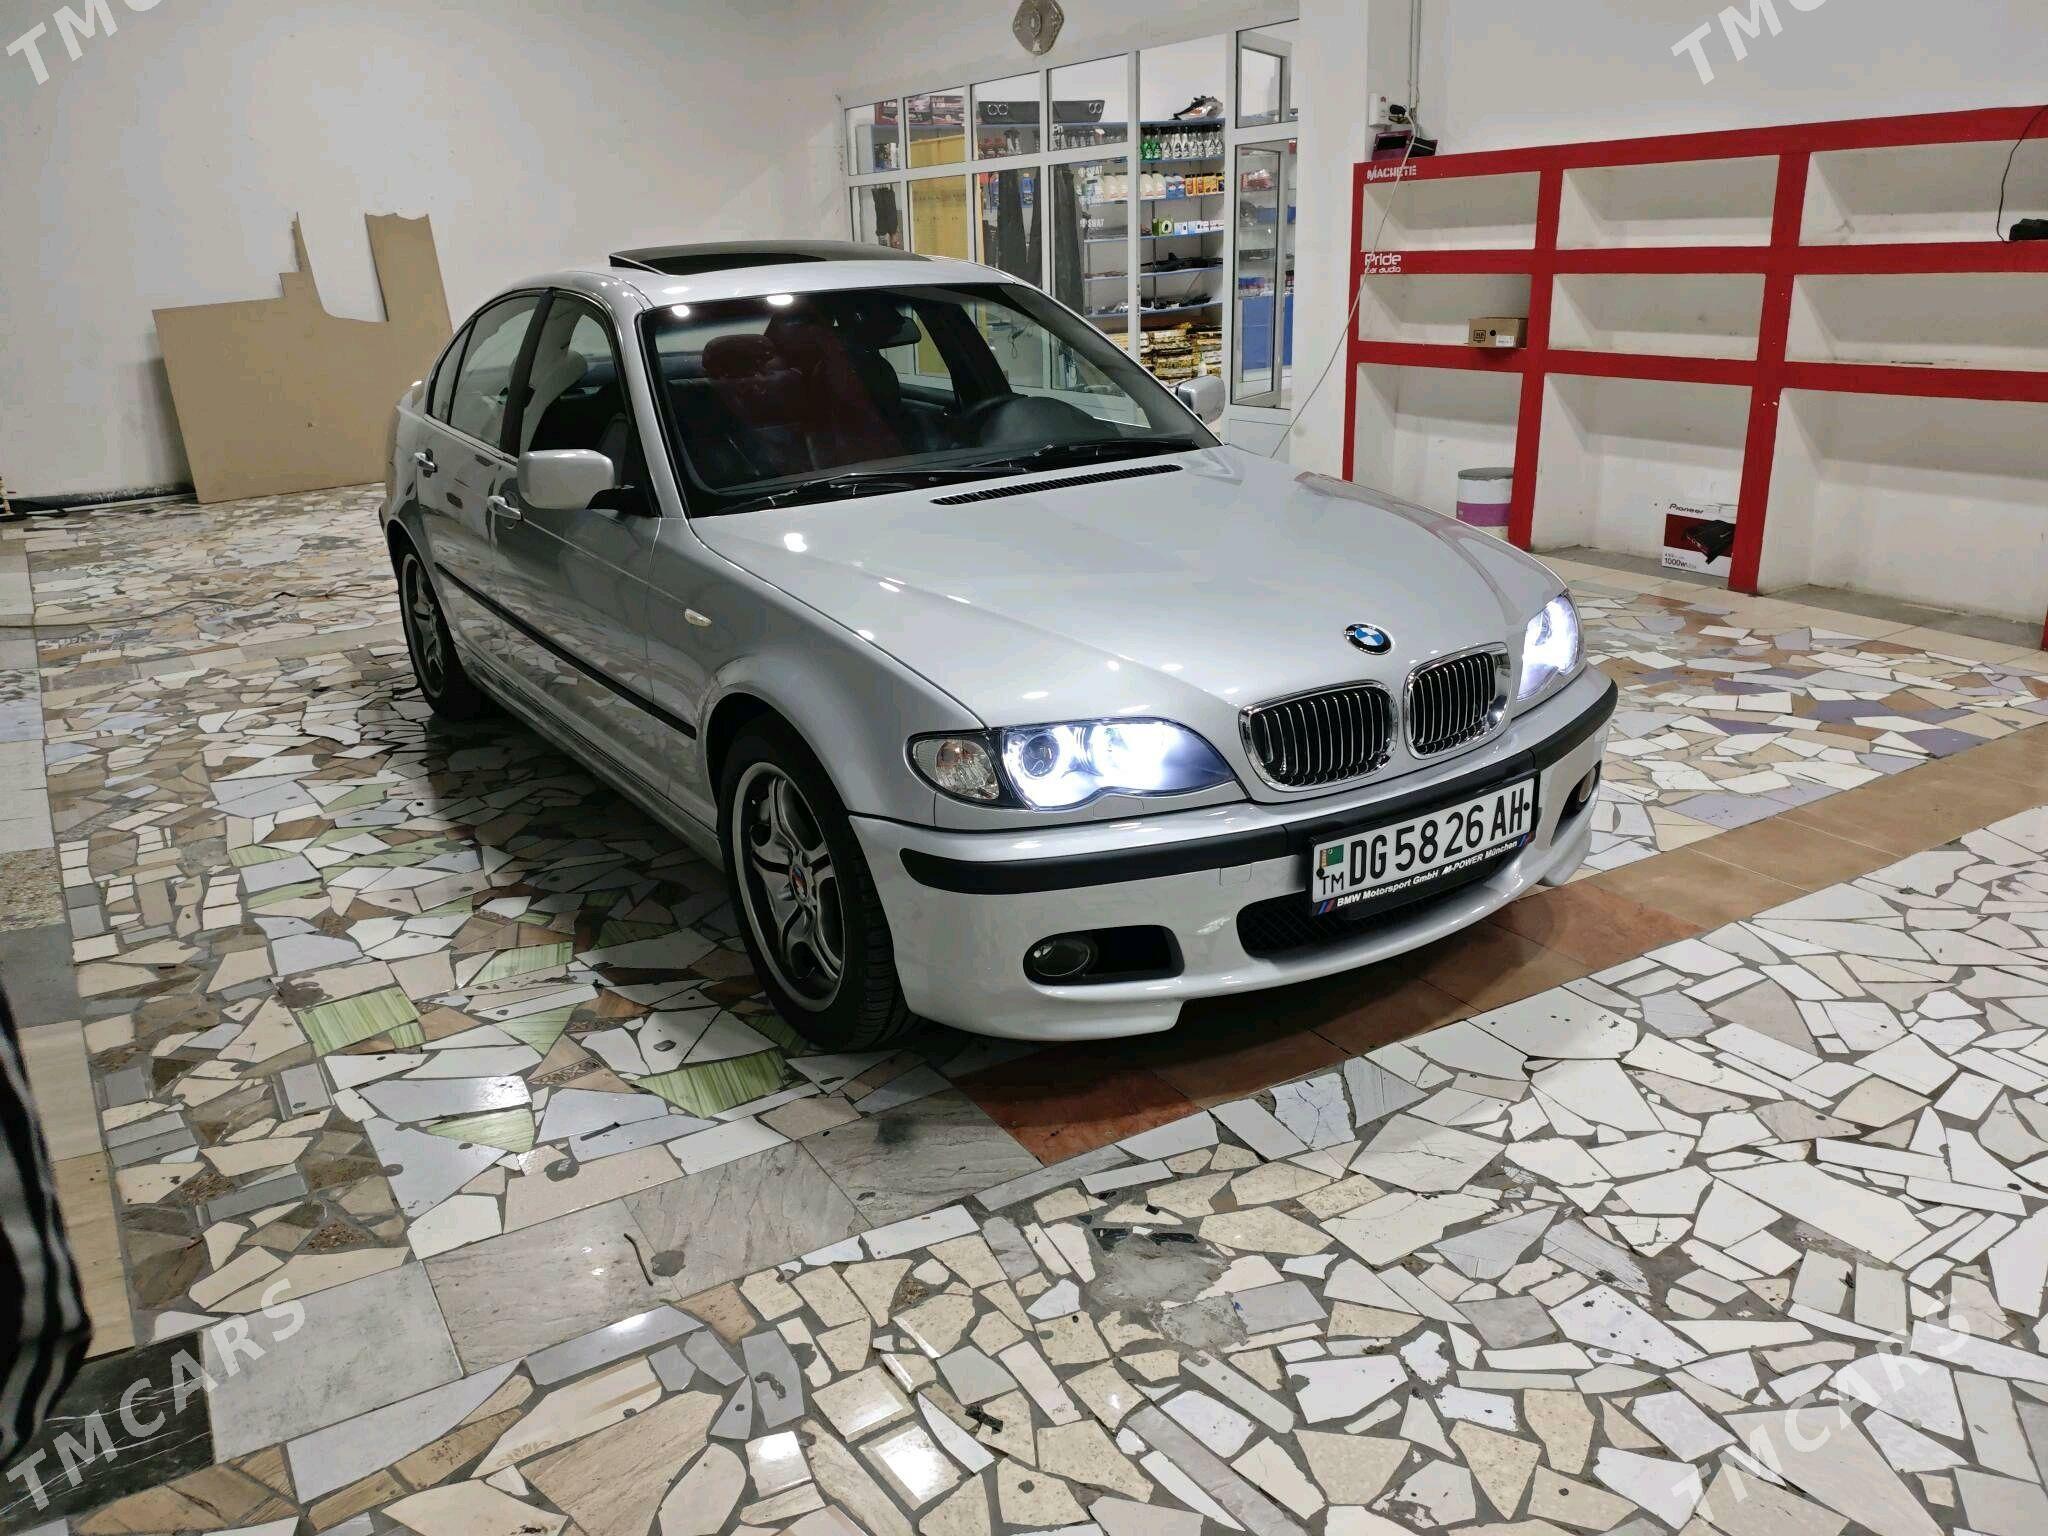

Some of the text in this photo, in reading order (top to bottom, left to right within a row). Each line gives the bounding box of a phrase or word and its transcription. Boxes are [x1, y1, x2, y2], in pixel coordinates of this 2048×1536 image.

[1367, 165, 1417, 181] MACHETE
[1365, 252, 1402, 266] Pride
[1669, 503, 1704, 514] Pioneer
[1320, 871, 1344, 896] TM
[1336, 892, 1361, 907] BMW
[1362, 878, 1412, 900] Motorsport
[1412, 868, 1440, 886] GmbH
